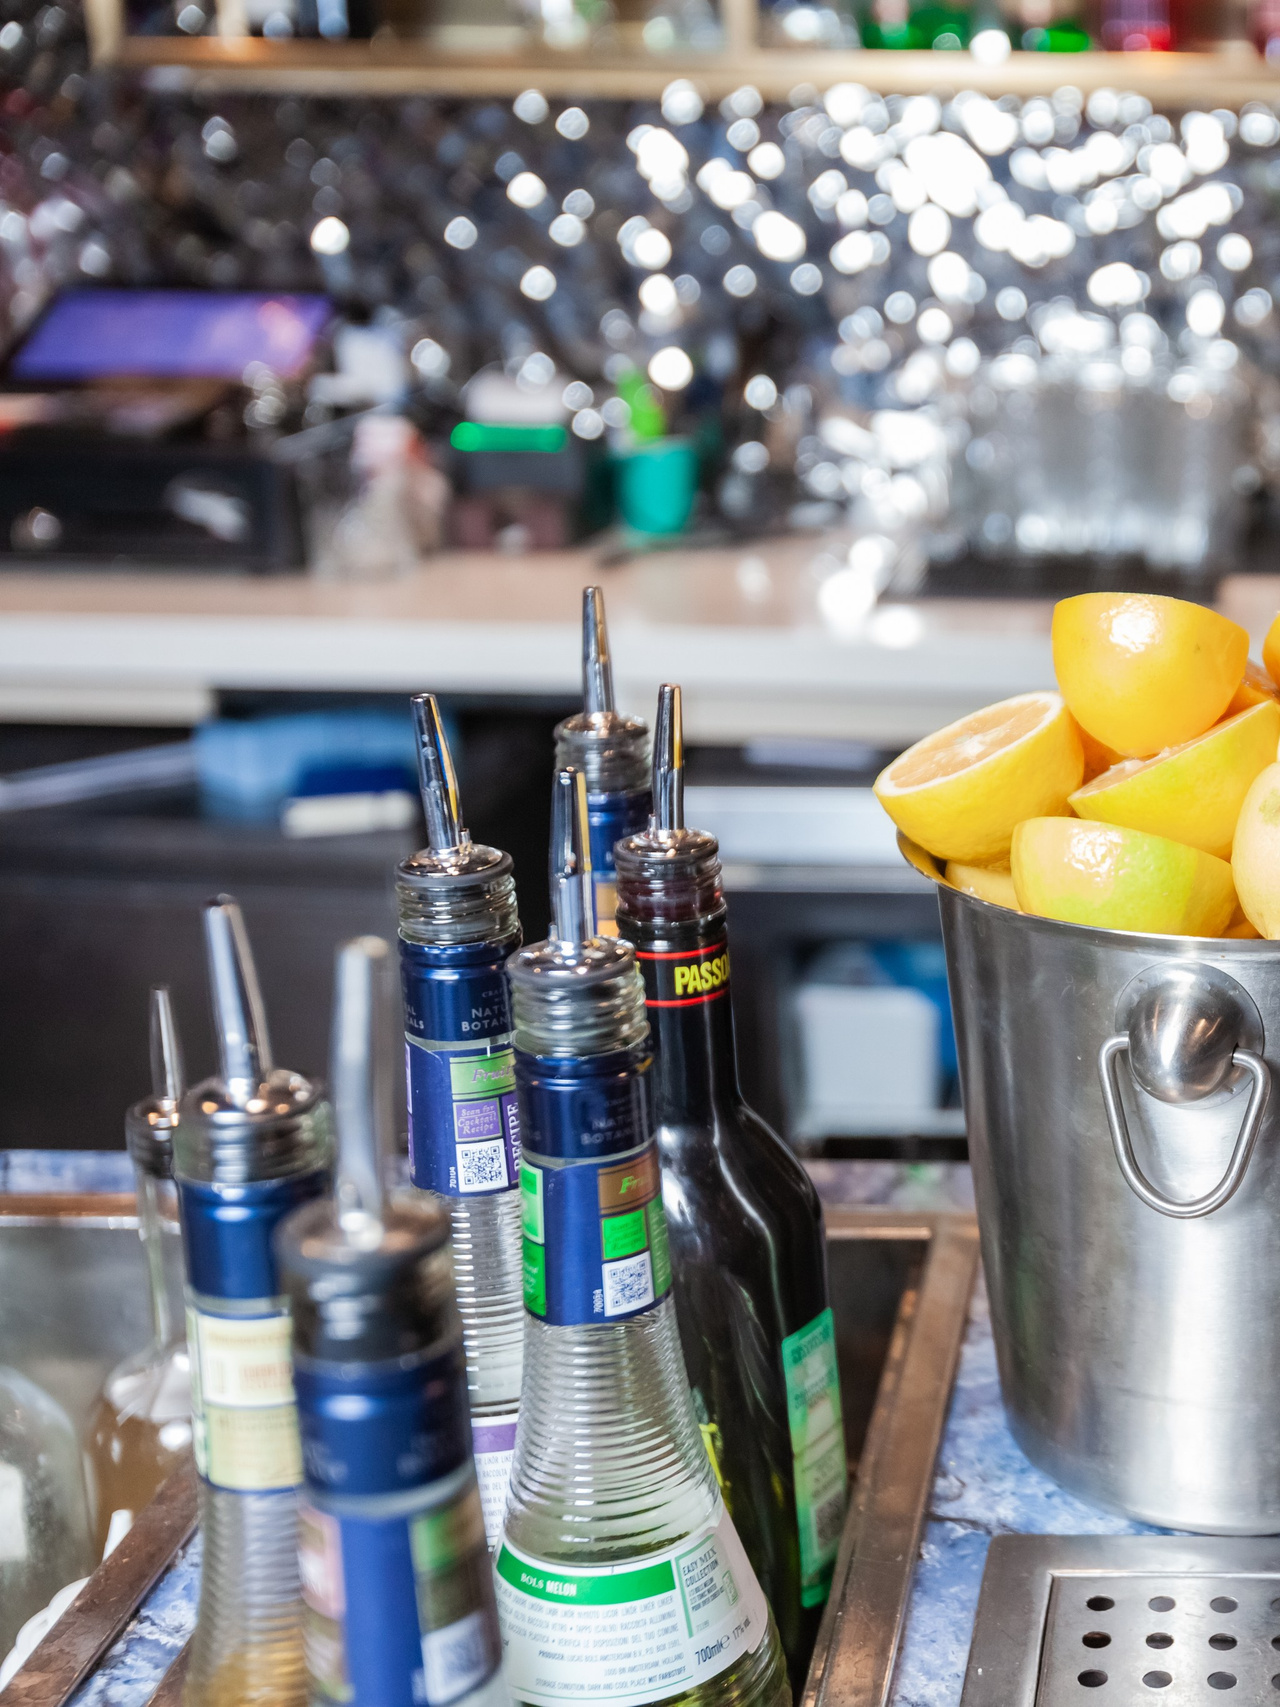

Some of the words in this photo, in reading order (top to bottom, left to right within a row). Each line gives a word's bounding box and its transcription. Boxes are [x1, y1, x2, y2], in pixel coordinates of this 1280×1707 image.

[471, 1003, 507, 1019] NATU
[461, 1016, 508, 1032] BOTAN
[458, 1111, 497, 1127] Cocktail
[461, 1108, 481, 1117] Scan
[463, 1122, 494, 1134] Recipe
[682, 1560, 698, 1577] EASY
[698, 1545, 717, 1567] MIX
[685, 1558, 719, 1588] COLLECTION
[520, 1573, 544, 1589] BOLS
[545, 1579, 578, 1597] MELON
